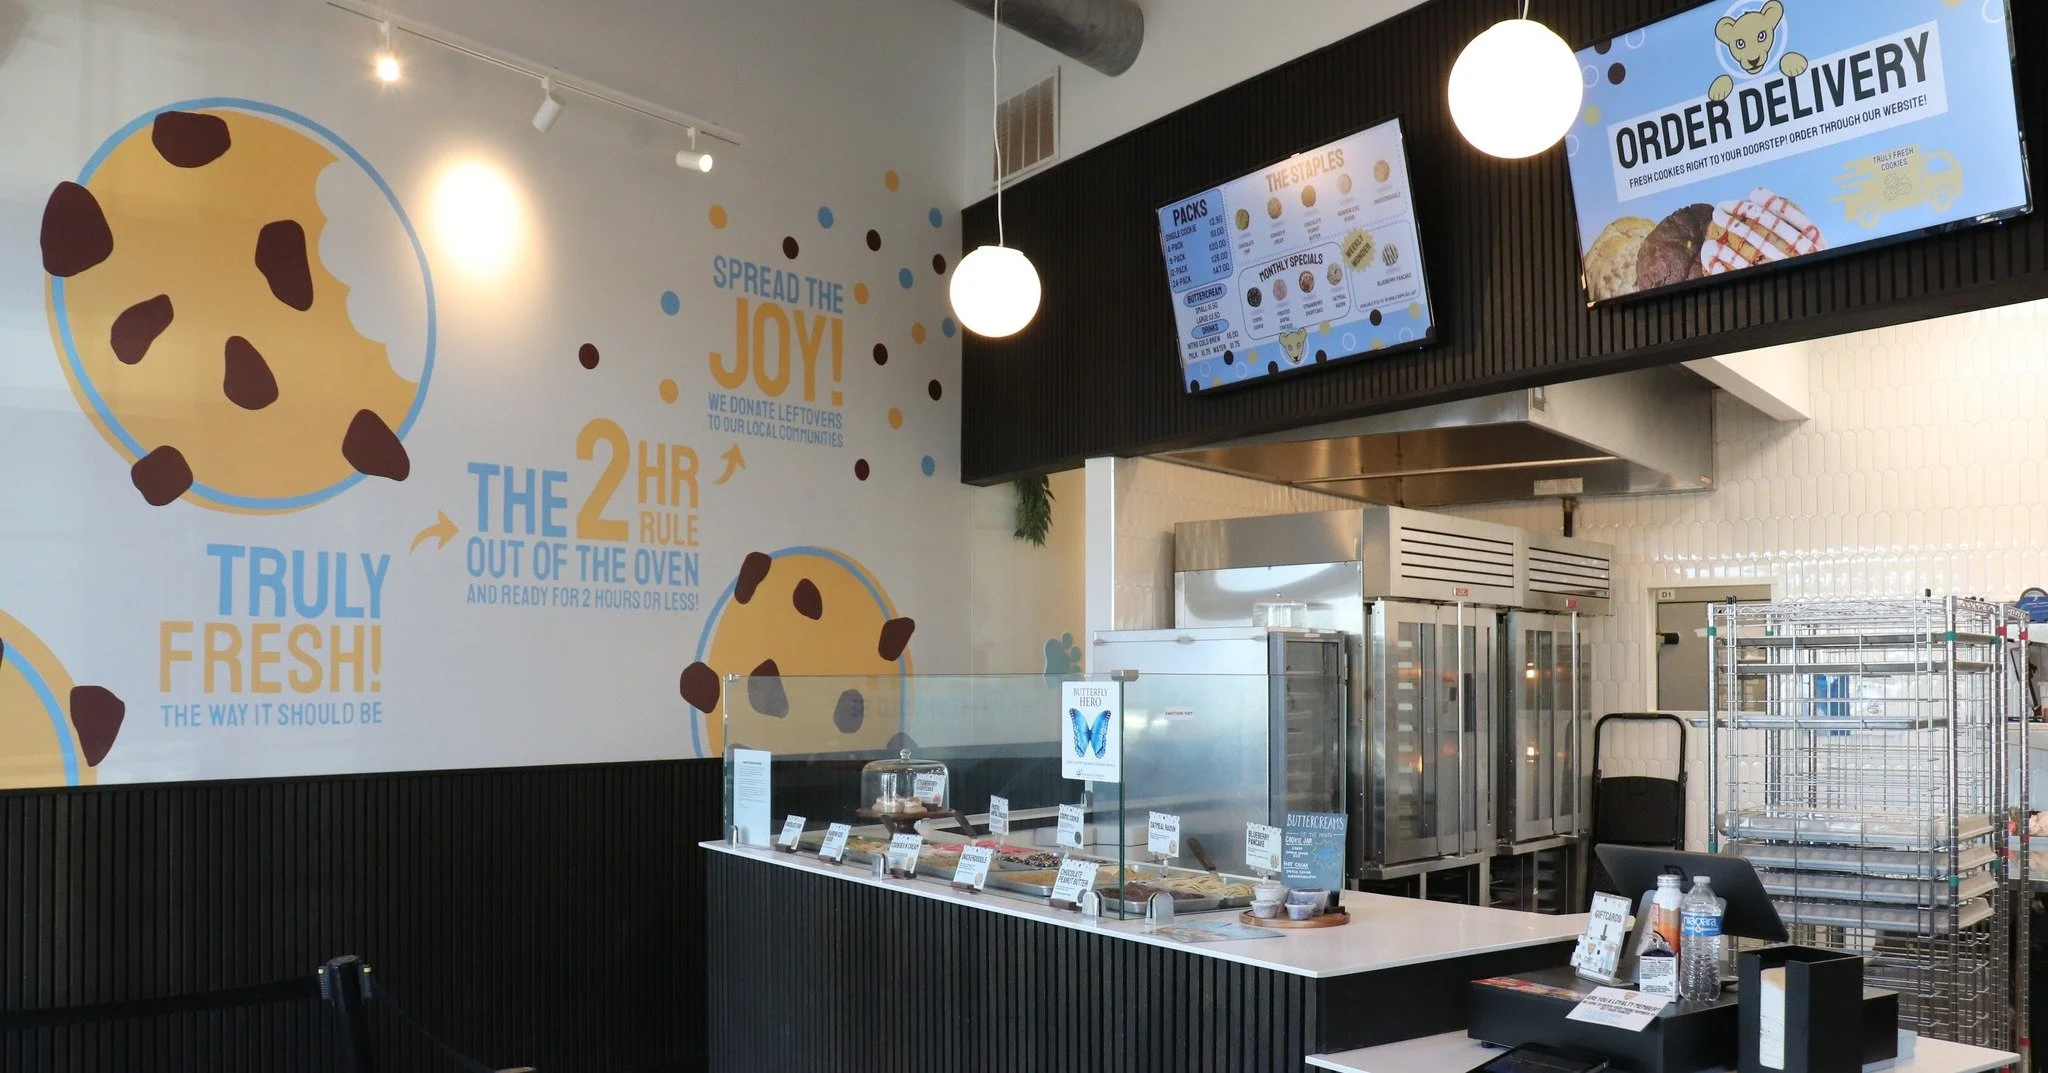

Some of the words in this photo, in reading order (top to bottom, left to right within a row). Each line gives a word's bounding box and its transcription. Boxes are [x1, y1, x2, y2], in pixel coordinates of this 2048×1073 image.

[1615, 99, 1733, 171] ORDER
[1738, 31, 1930, 135] DELIVERY
[1629, 173, 1653, 189] FRESH
[1653, 163, 1685, 182] COOKIES
[1686, 157, 1709, 173] RIGHT
[1709, 154, 1720, 166] TO
[1720, 148, 1743, 164] YOUR
[1742, 135, 1788, 158] DOORSTEP!
[1789, 126, 1819, 144] ORDER
[1819, 115, 1861, 137] THROUGH
[1862, 109, 1882, 123] OUR
[1883, 94, 1928, 117] WEBSITE!
[1872, 153, 1892, 164] TRULY
[1893, 147, 1914, 159] FRESH
[1265, 168, 1290, 192] THE
[1290, 148, 1345, 184] STAPLES
[1881, 158, 1908, 171] COOKIES
[1172, 198, 1208, 227] PACKS
[1259, 258, 1290, 282] MONTHLY
[1290, 253, 1323, 268] SPECIALS
[713, 255, 800, 304] SPREAD
[805, 276, 843, 315] THE
[1187, 285, 1223, 304] BUTTERCREAM
[1201, 323, 1219, 334] DRINKS
[709, 297, 843, 406] JOY!
[708, 392, 727, 412] WE
[730, 396, 775, 420] DONATE
[778, 403, 843, 430] LEFTOVERS
[708, 414, 720, 430] TO
[723, 417, 745, 433] OUR
[747, 420, 777, 439] LOCAL
[779, 424, 844, 448] COMMUNITIES
[467, 462, 568, 538] THE
[576, 417, 630, 542] 2
[637, 440, 699, 509] HR
[640, 511, 699, 547] RULE
[466, 536, 525, 578] OUT
[533, 540, 568, 580] OF
[575, 544, 626, 583] THE
[634, 548, 700, 588] OVEN
[207, 543, 392, 619] TRULY
[467, 583, 498, 605] AND
[501, 584, 548, 607] READY
[552, 586, 579, 607] FOR
[582, 588, 591, 608] 2
[595, 588, 640, 610] HOURS
[643, 590, 661, 610] OR
[664, 592, 700, 612] LESS!
[159, 621, 382, 694] FRESH!
[1073, 687, 1108, 697] BUTTERFLY
[1079, 696, 1102, 707] HERO
[160, 704, 201, 727] THE
[208, 704, 248, 727] WAY
[255, 703, 272, 725] IT
[277, 703, 354, 726] SHOULD
[360, 702, 383, 724] BE
[1247, 830, 1270, 840] BLUEBERRY
[1286, 813, 1345, 830] BUTTERCREAMS
[1247, 838, 1265, 847] PANCAKE
[1060, 868, 1083, 878] CHOCOLATE
[1594, 909, 1622, 923] GIFTCARDS
